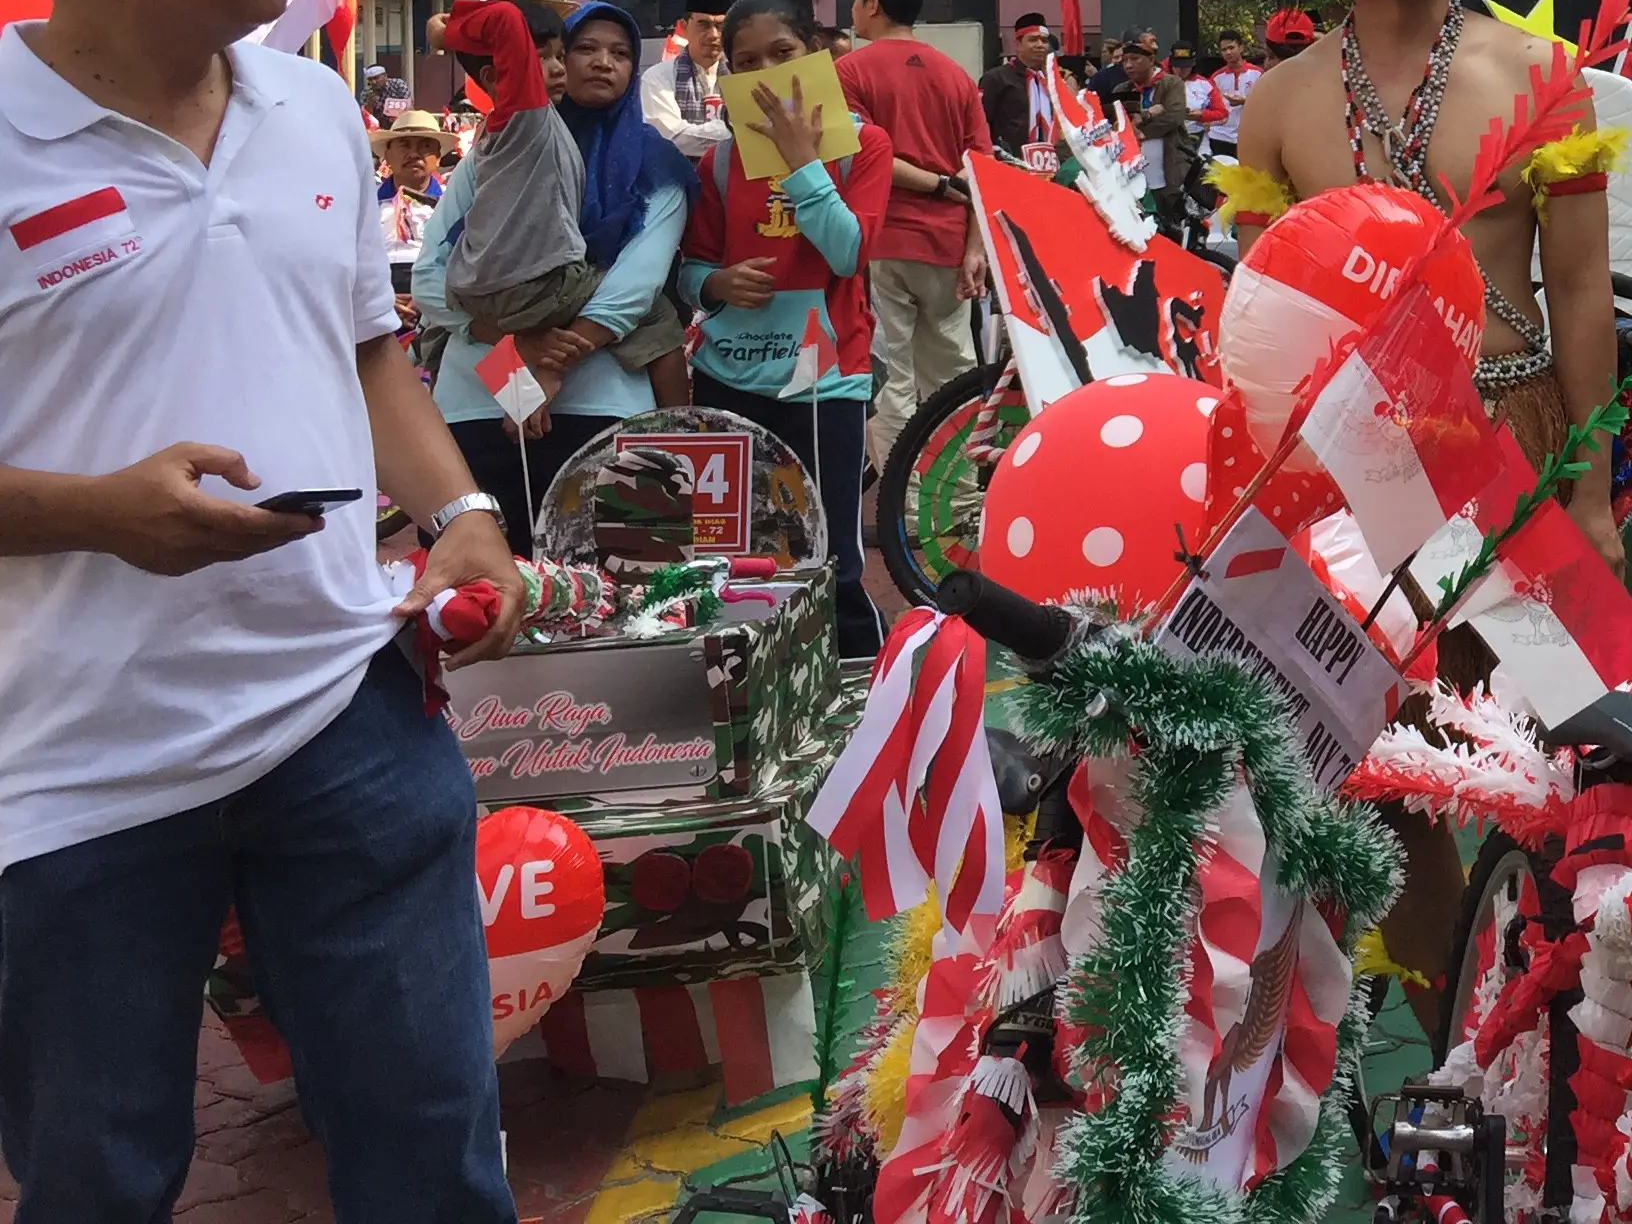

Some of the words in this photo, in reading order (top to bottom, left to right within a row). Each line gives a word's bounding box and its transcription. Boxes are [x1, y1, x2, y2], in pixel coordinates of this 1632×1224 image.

[36, 247, 119, 290] INDONESIA
[1294, 596, 1367, 686] HAPPY
[501, 738, 593, 779] Untuk
[592, 731, 714, 776] Indonesia
